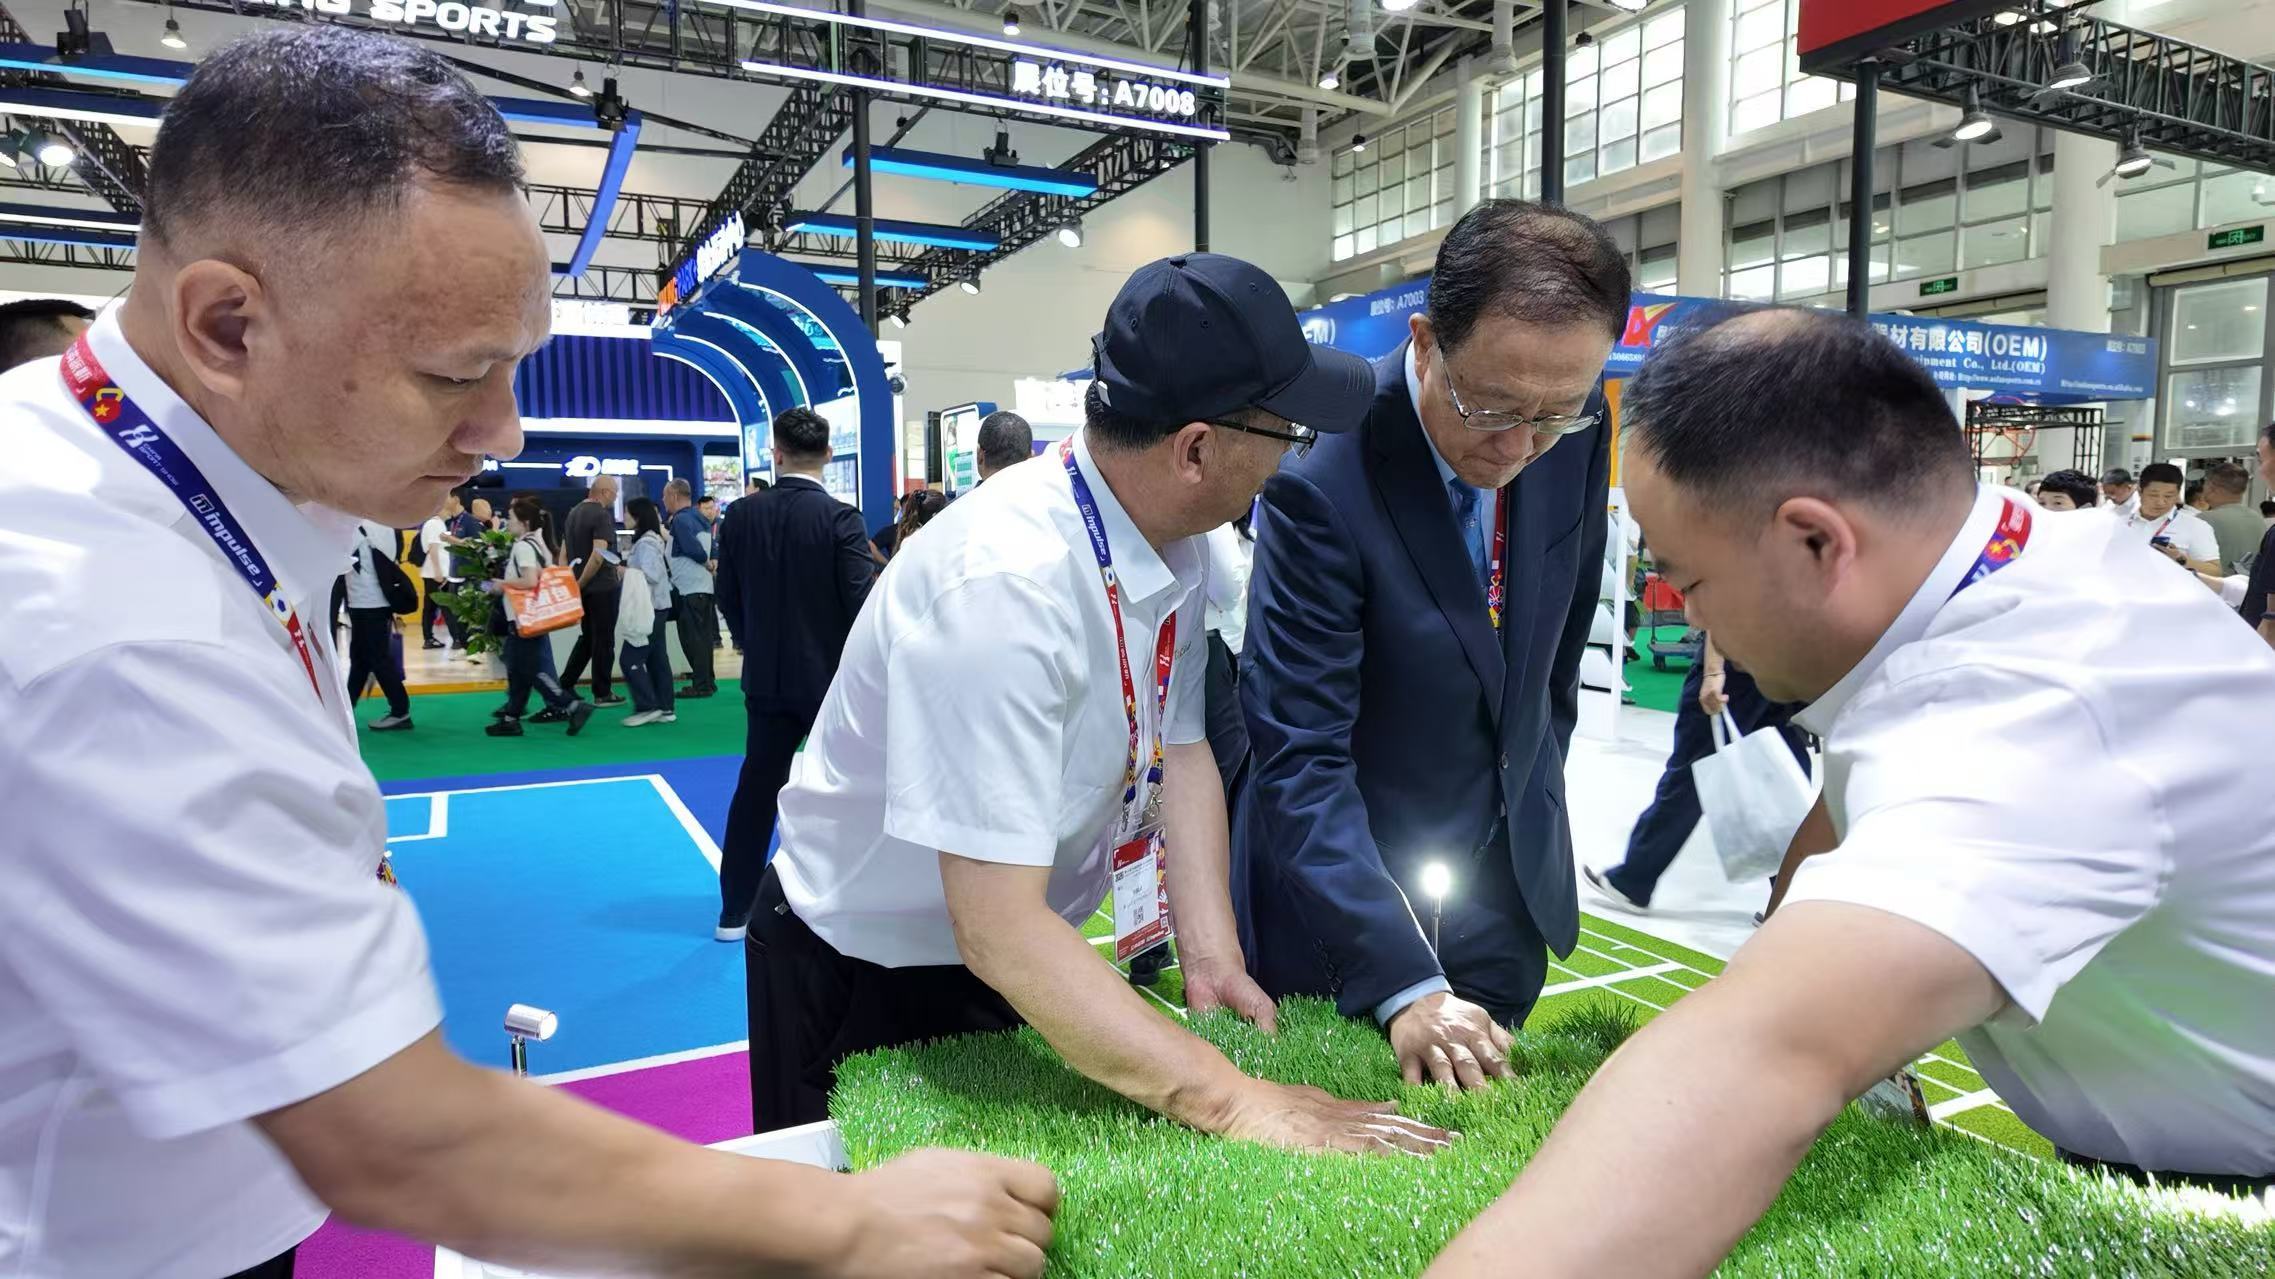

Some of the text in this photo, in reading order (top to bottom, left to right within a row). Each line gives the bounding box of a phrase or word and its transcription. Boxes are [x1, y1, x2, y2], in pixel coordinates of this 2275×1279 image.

[369, 0, 557, 43] SPORTS
[204, 511, 261, 577] impulse
[1086, 514, 1107, 556] impulse
